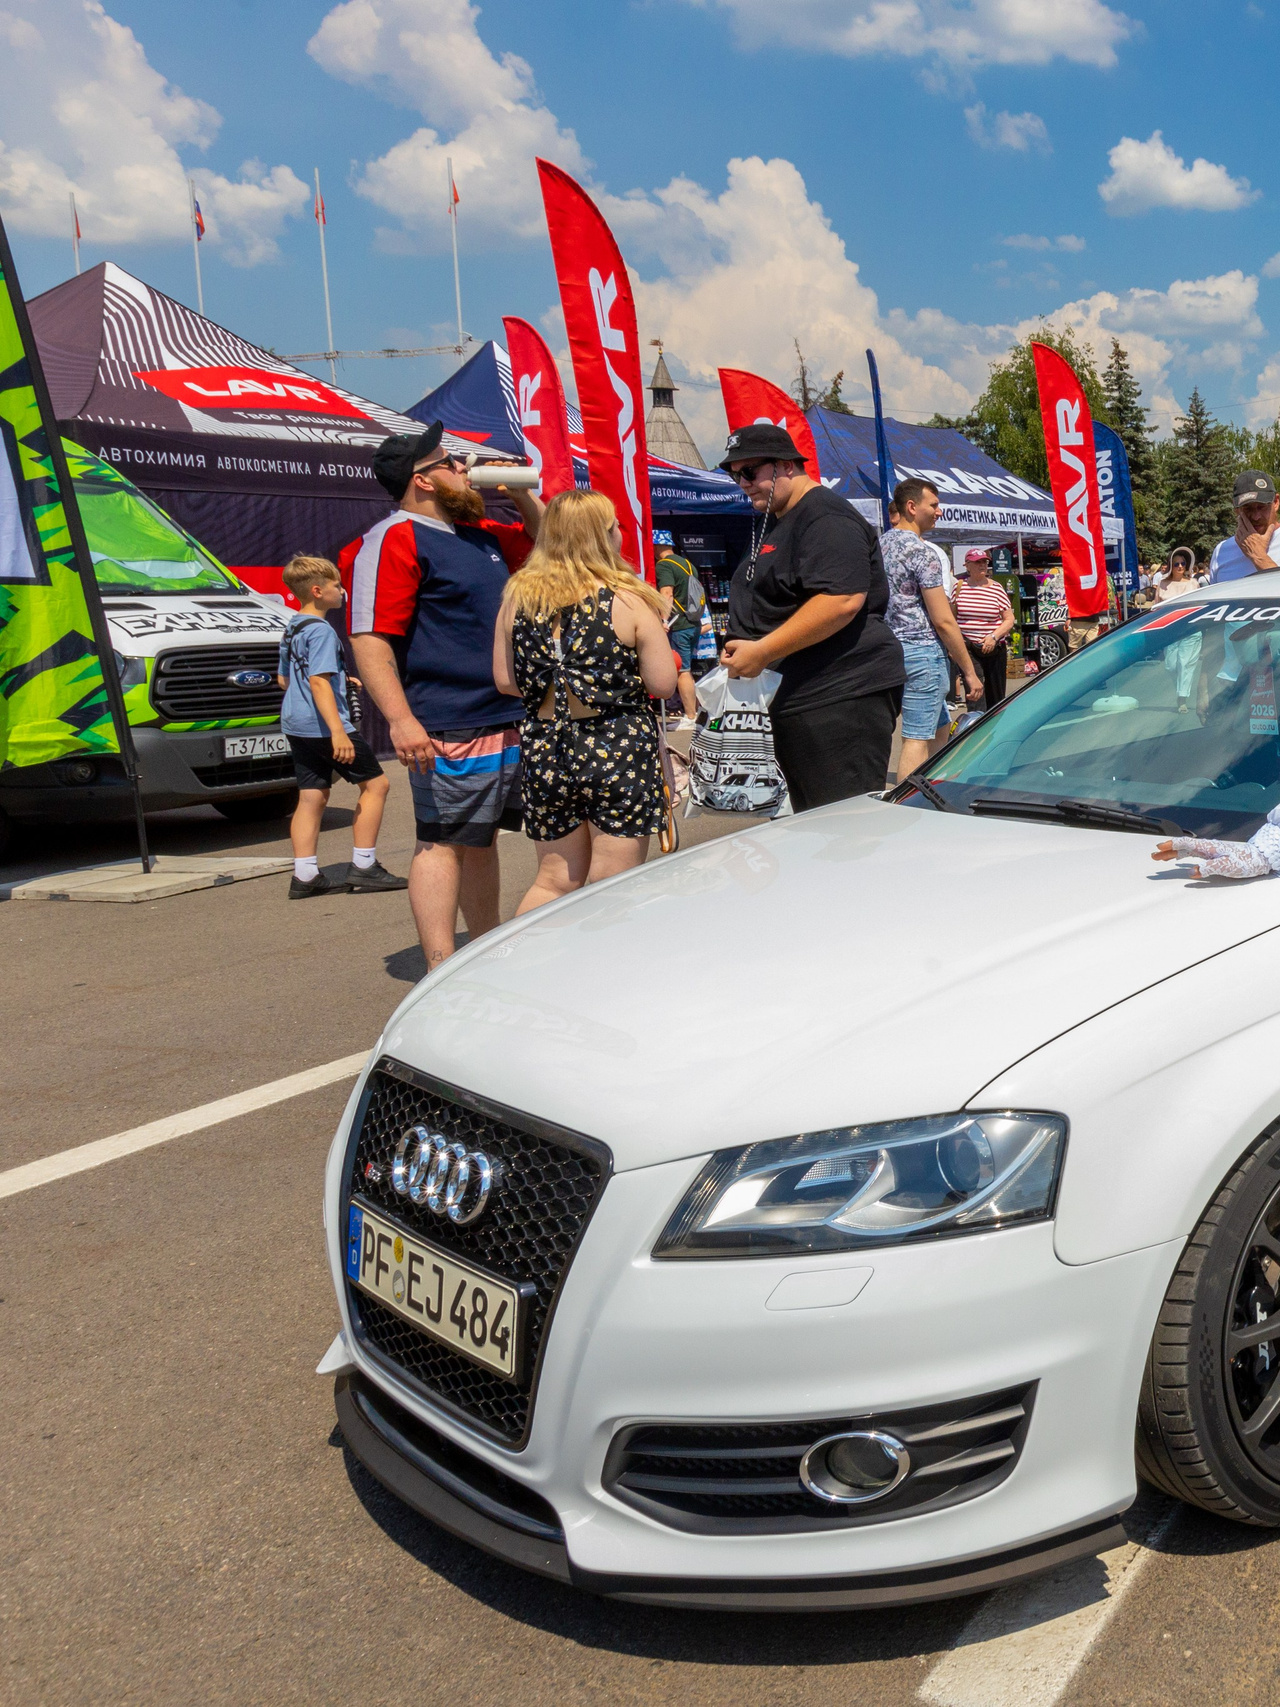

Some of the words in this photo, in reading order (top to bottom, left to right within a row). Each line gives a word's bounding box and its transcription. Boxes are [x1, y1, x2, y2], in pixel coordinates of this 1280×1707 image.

[183, 379, 328, 404] LAVR
[289, 413, 365, 429] решение
[99, 446, 206, 468] АВТОХИМИЯ
[217, 456, 311, 475] АВТОКОСМЕТИКА
[318, 463, 376, 479] АВТОХИ
[651, 487, 698, 499] АВТОХИМИЯ
[1055, 398, 1098, 590] LAVR
[938, 508, 997, 525] КОСМЕТИКА
[999, 511, 1018, 527] ДЛЯ
[1019, 512, 1048, 528] МОЙКИ
[683, 537, 704, 545] LAVR
[243, 673, 266, 685] Ford
[1251, 704, 1275, 716] 2026
[351, 1250, 358, 1265] D
[362, 1221, 393, 1286] PF
[407, 1250, 445, 1323] EJ
[450, 1279, 510, 1361] 484
